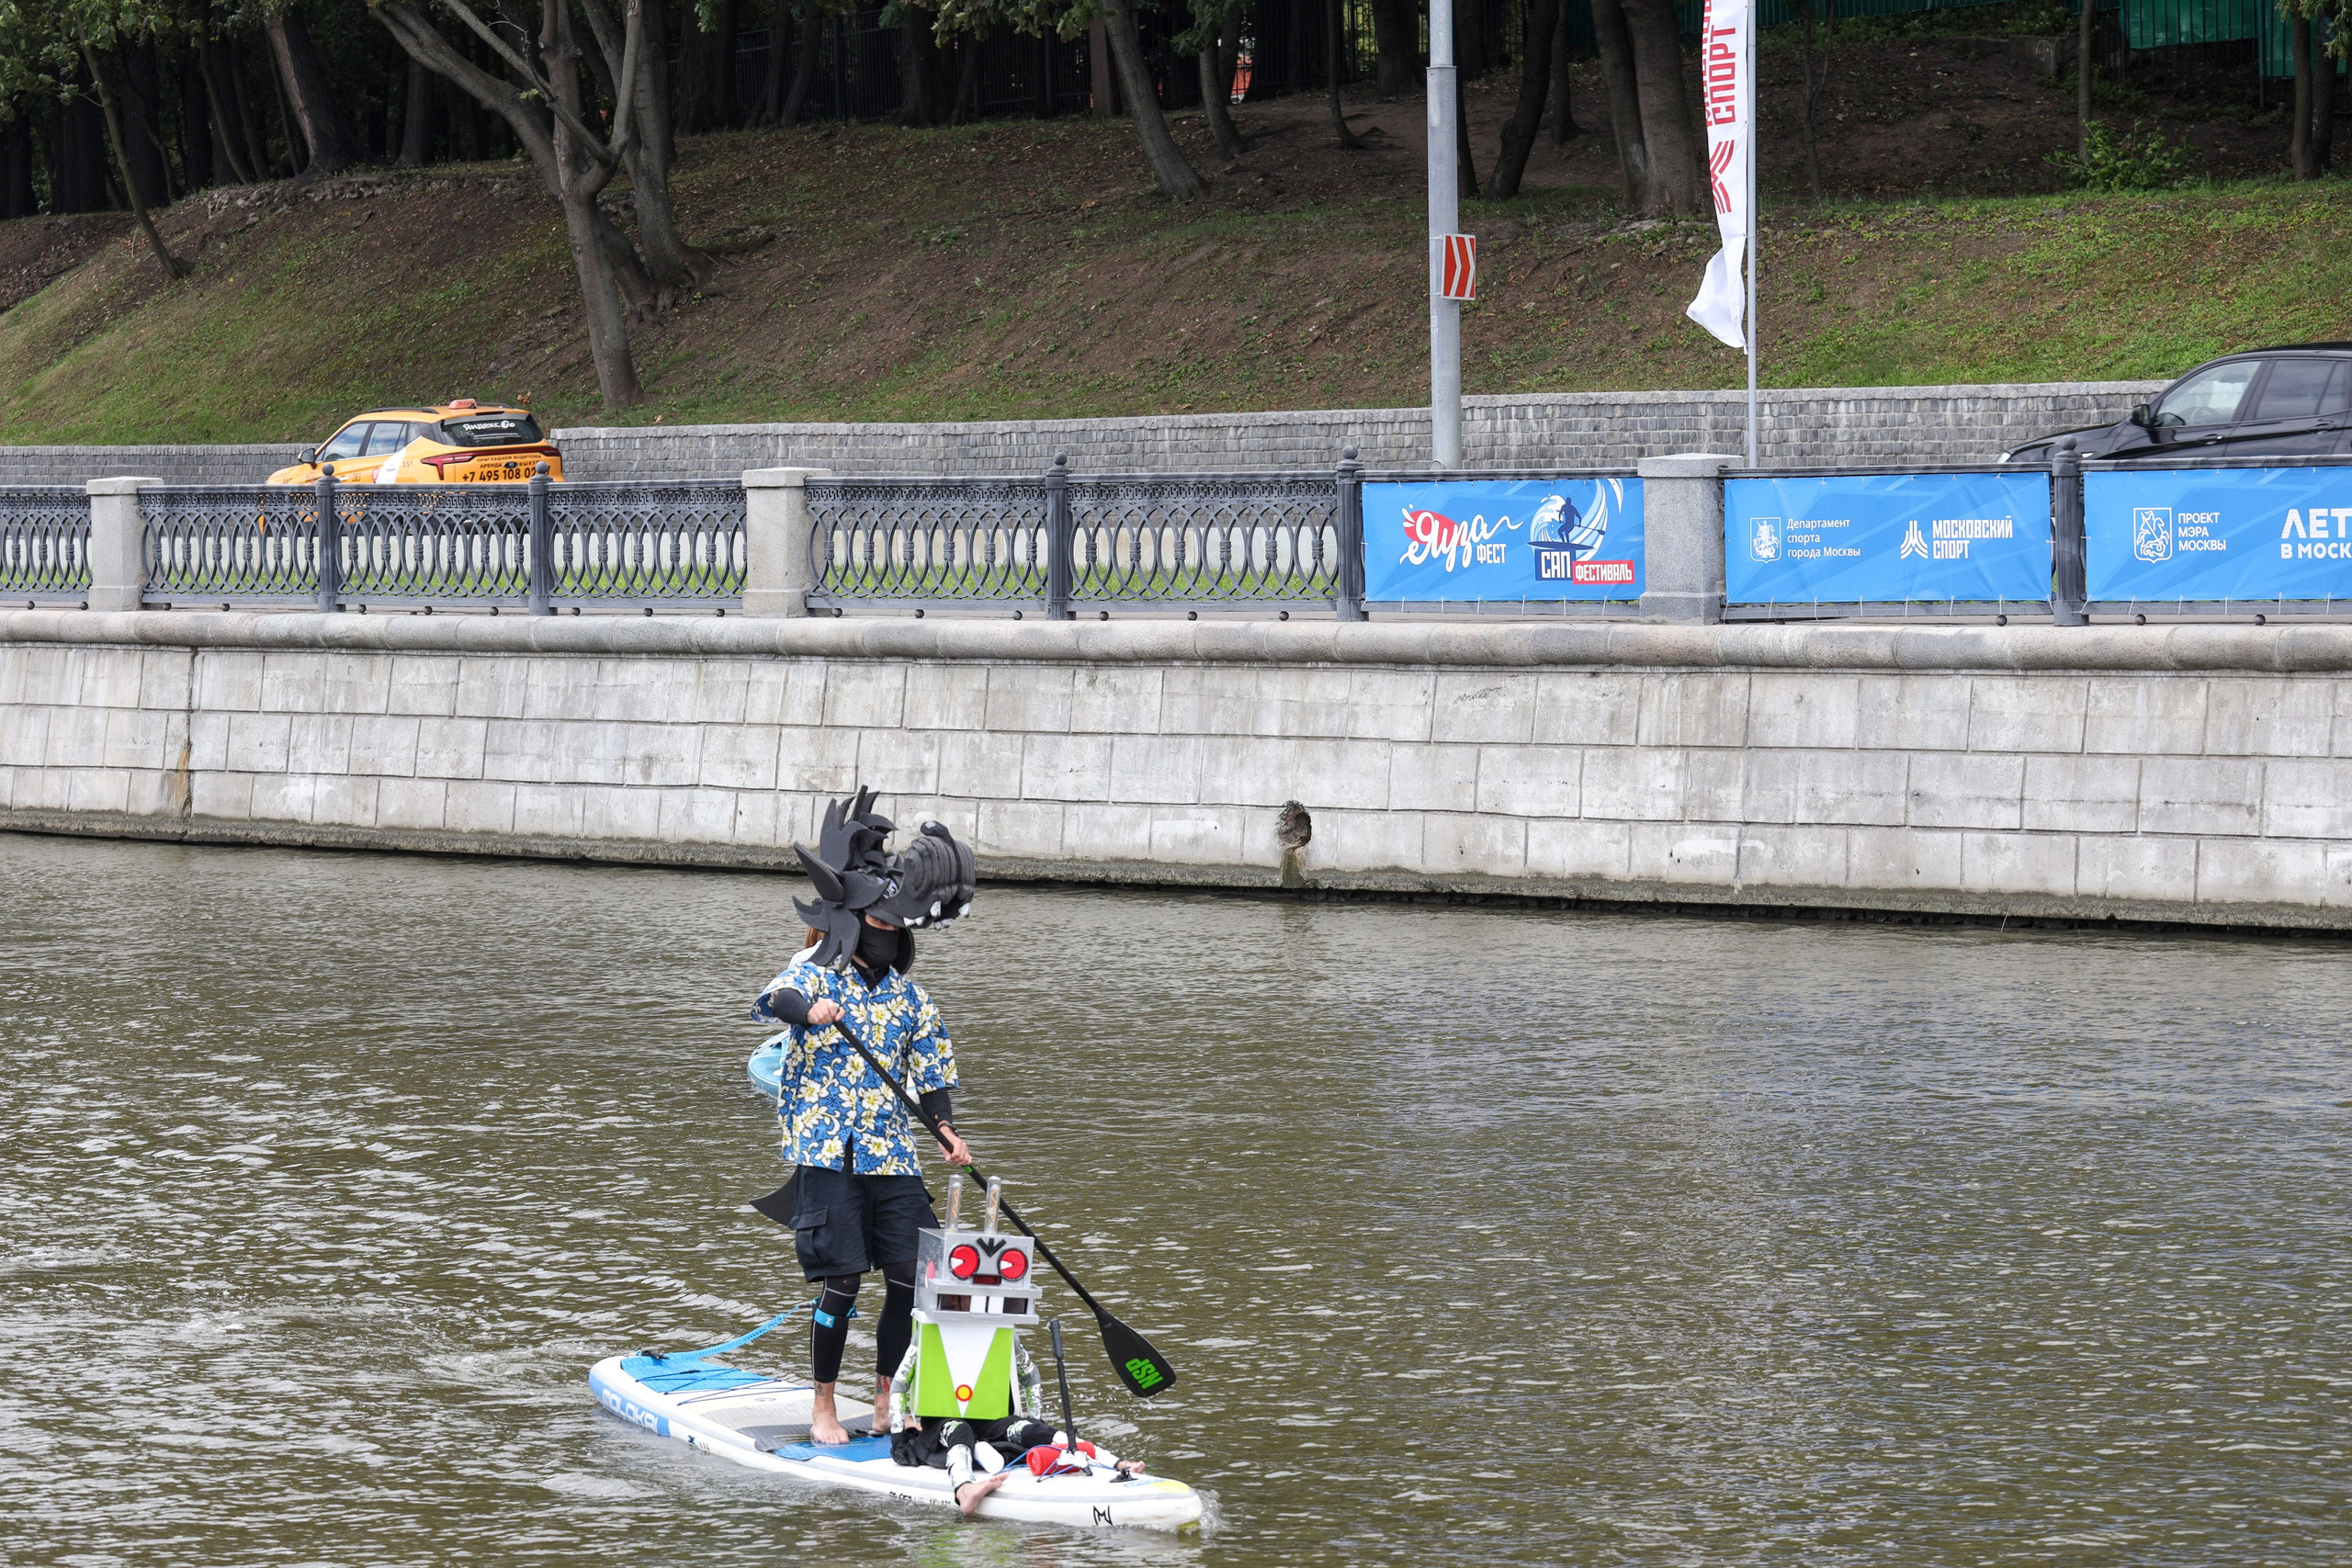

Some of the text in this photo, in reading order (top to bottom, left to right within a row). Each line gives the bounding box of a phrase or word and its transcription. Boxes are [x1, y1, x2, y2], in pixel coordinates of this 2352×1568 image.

[1708, 24, 1736, 126] СПОРТ
[462, 422, 501, 431] Яндекс
[462, 471, 476, 482] +7
[479, 469, 499, 482] 495
[503, 468, 521, 480] 108
[1786, 517, 1850, 530] Департамент
[2177, 512, 2220, 525] ПРОЕКТ
[1932, 515, 2013, 538] МОСКОВСКИЙ
[2177, 526, 2210, 538] МЭРА
[1787, 534, 1821, 546] спорта
[2178, 539, 2227, 551] МОСКВЫ
[1476, 543, 1507, 564] ФЕСТ
[1787, 547, 1861, 560] города Москвы
[1932, 539, 1971, 559] СПОРТ
[2280, 543, 2293, 559] В
[1540, 550, 1634, 581] САП ФЕСТИВАЛЬ
[1125, 1358, 1164, 1390] NSP
[602, 1388, 659, 1433] MOLOKAI
